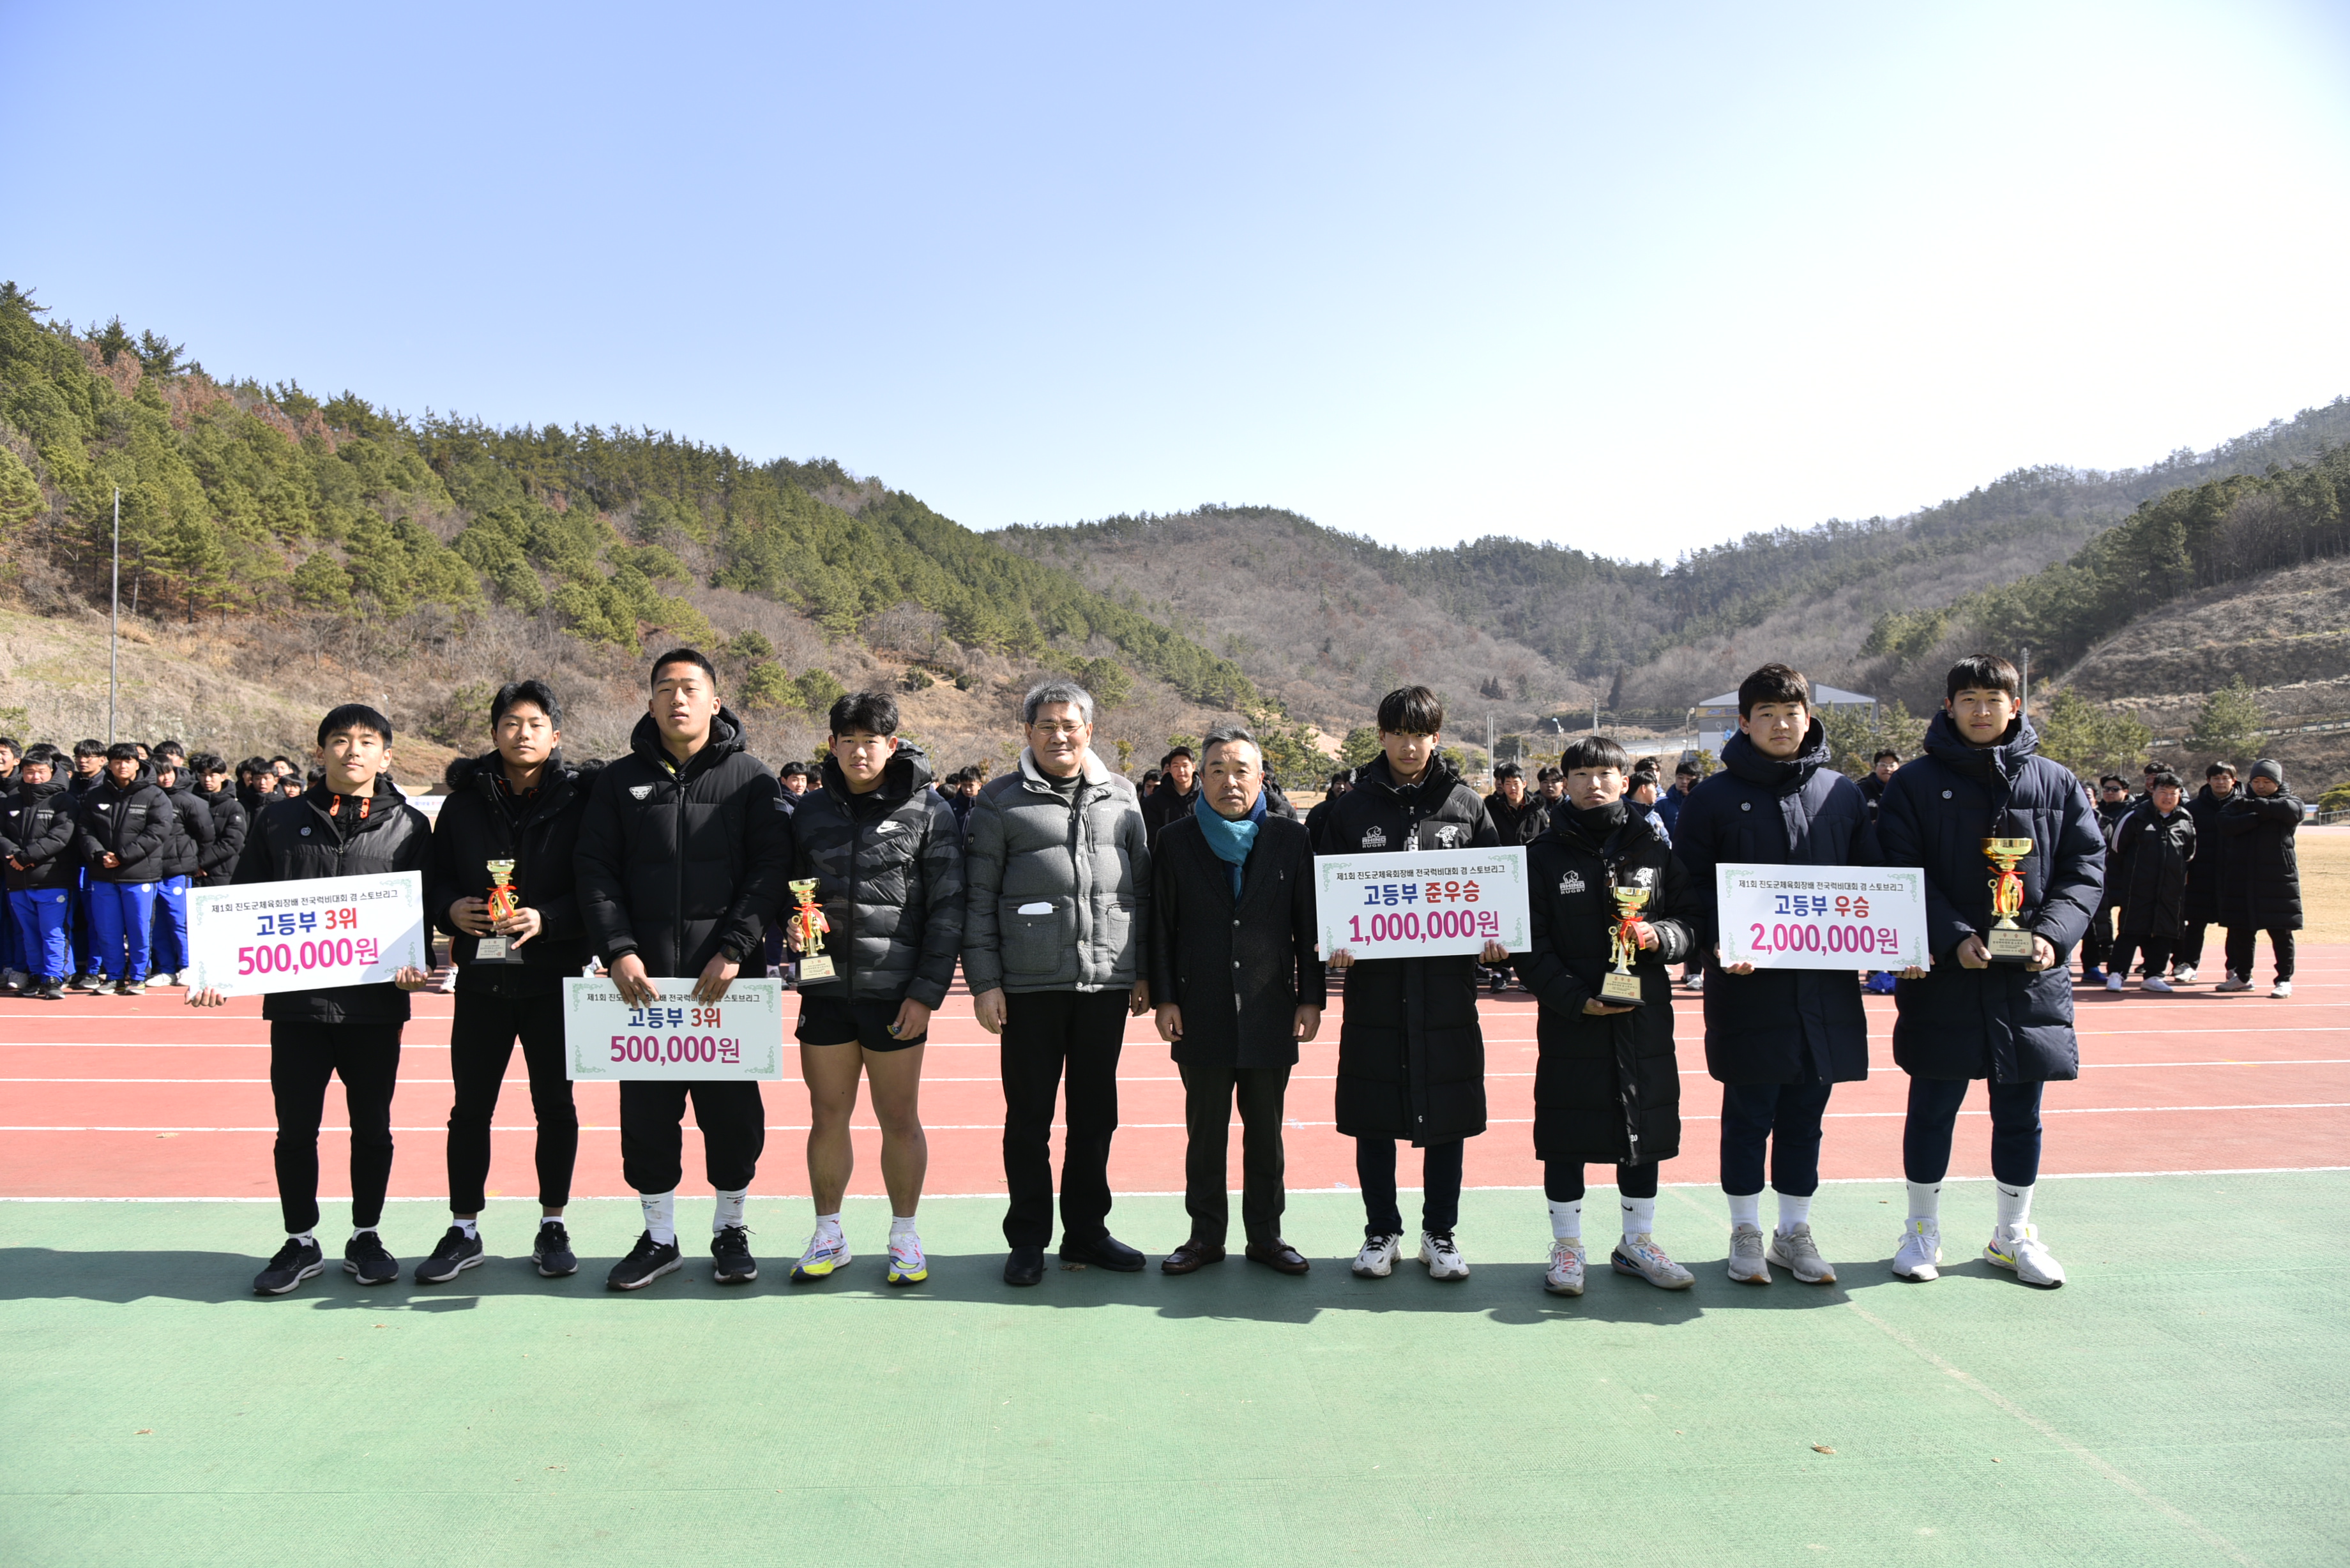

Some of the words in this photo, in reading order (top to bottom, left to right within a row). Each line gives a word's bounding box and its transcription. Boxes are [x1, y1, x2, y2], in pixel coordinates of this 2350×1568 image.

[1336, 871, 1356, 880] 제1회
[1357, 869, 1414, 880] 진도군체육회장배
[1416, 867, 1459, 877] 전국럭비대회
[1460, 866, 1467, 875] 겸
[1469, 865, 1505, 875] 스토브리그
[1363, 882, 1418, 906] 고등부
[1425, 880, 1480, 903] 준우승
[1559, 882, 1585, 890] RHINO
[1738, 880, 1757, 889] 제1회
[1759, 880, 1815, 890] 진도군체육회장배
[1816, 881, 1858, 891] 전국럭비대회
[1860, 882, 1867, 891] 겸
[1869, 882, 1904, 892] 스토브리그
[211, 903, 233, 913] 제1회
[235, 898, 299, 912] 진도군체육회장배
[301, 894, 348, 907] 전국럭비대회
[350, 893, 358, 902] 겸
[360, 890, 398, 901] 스토브리그
[1775, 894, 1828, 917] 고등부
[1834, 896, 1870, 918] 우승
[256, 911, 317, 936] 고등부
[324, 907, 358, 930] 3위
[1348, 910, 1499, 946] 1,000,000원
[1750, 923, 1899, 956] 2,000,000원
[238, 937, 379, 976] 500,000원
[587, 993, 607, 1002] 제1회
[724, 994, 761, 1002] 스토브리그
[628, 1007, 683, 1029] 고등부
[690, 1007, 721, 1029] 3위
[610, 1036, 740, 1066] 500,000원
